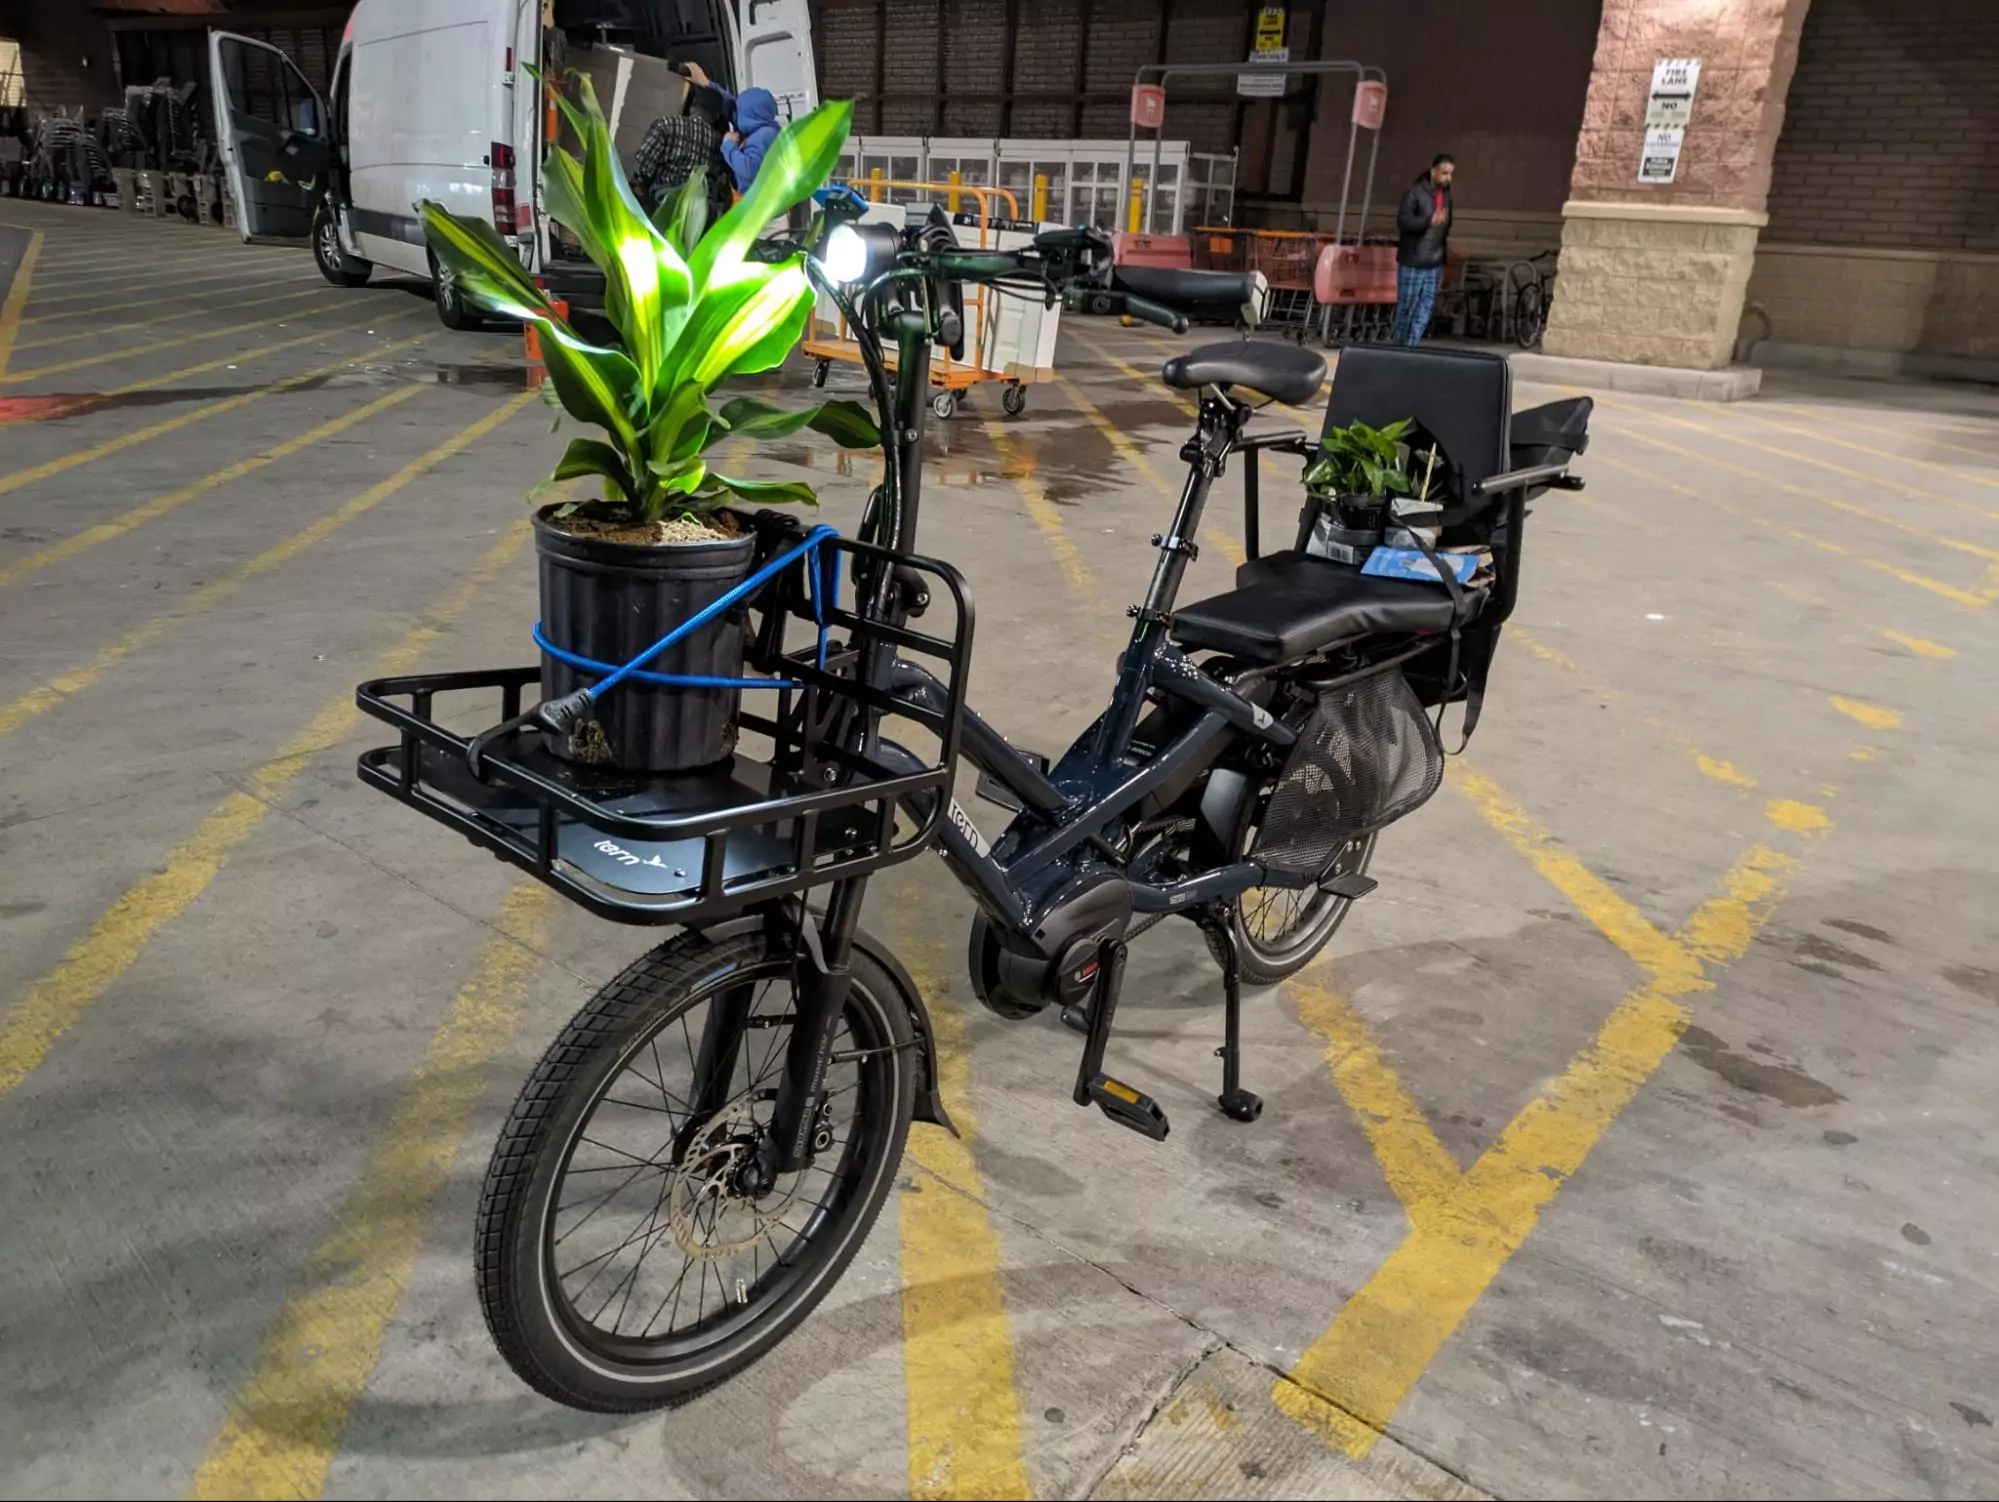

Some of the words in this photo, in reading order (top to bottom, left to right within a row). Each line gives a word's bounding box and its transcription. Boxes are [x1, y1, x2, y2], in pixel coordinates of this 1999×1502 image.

[1665, 68, 1688, 76] FIRE
[1661, 76, 1688, 85] LANE
[1661, 102, 1678, 110] NO
[1658, 133, 1671, 141] NO
[952, 803, 979, 849] tern
[593, 840, 640, 866] tern
